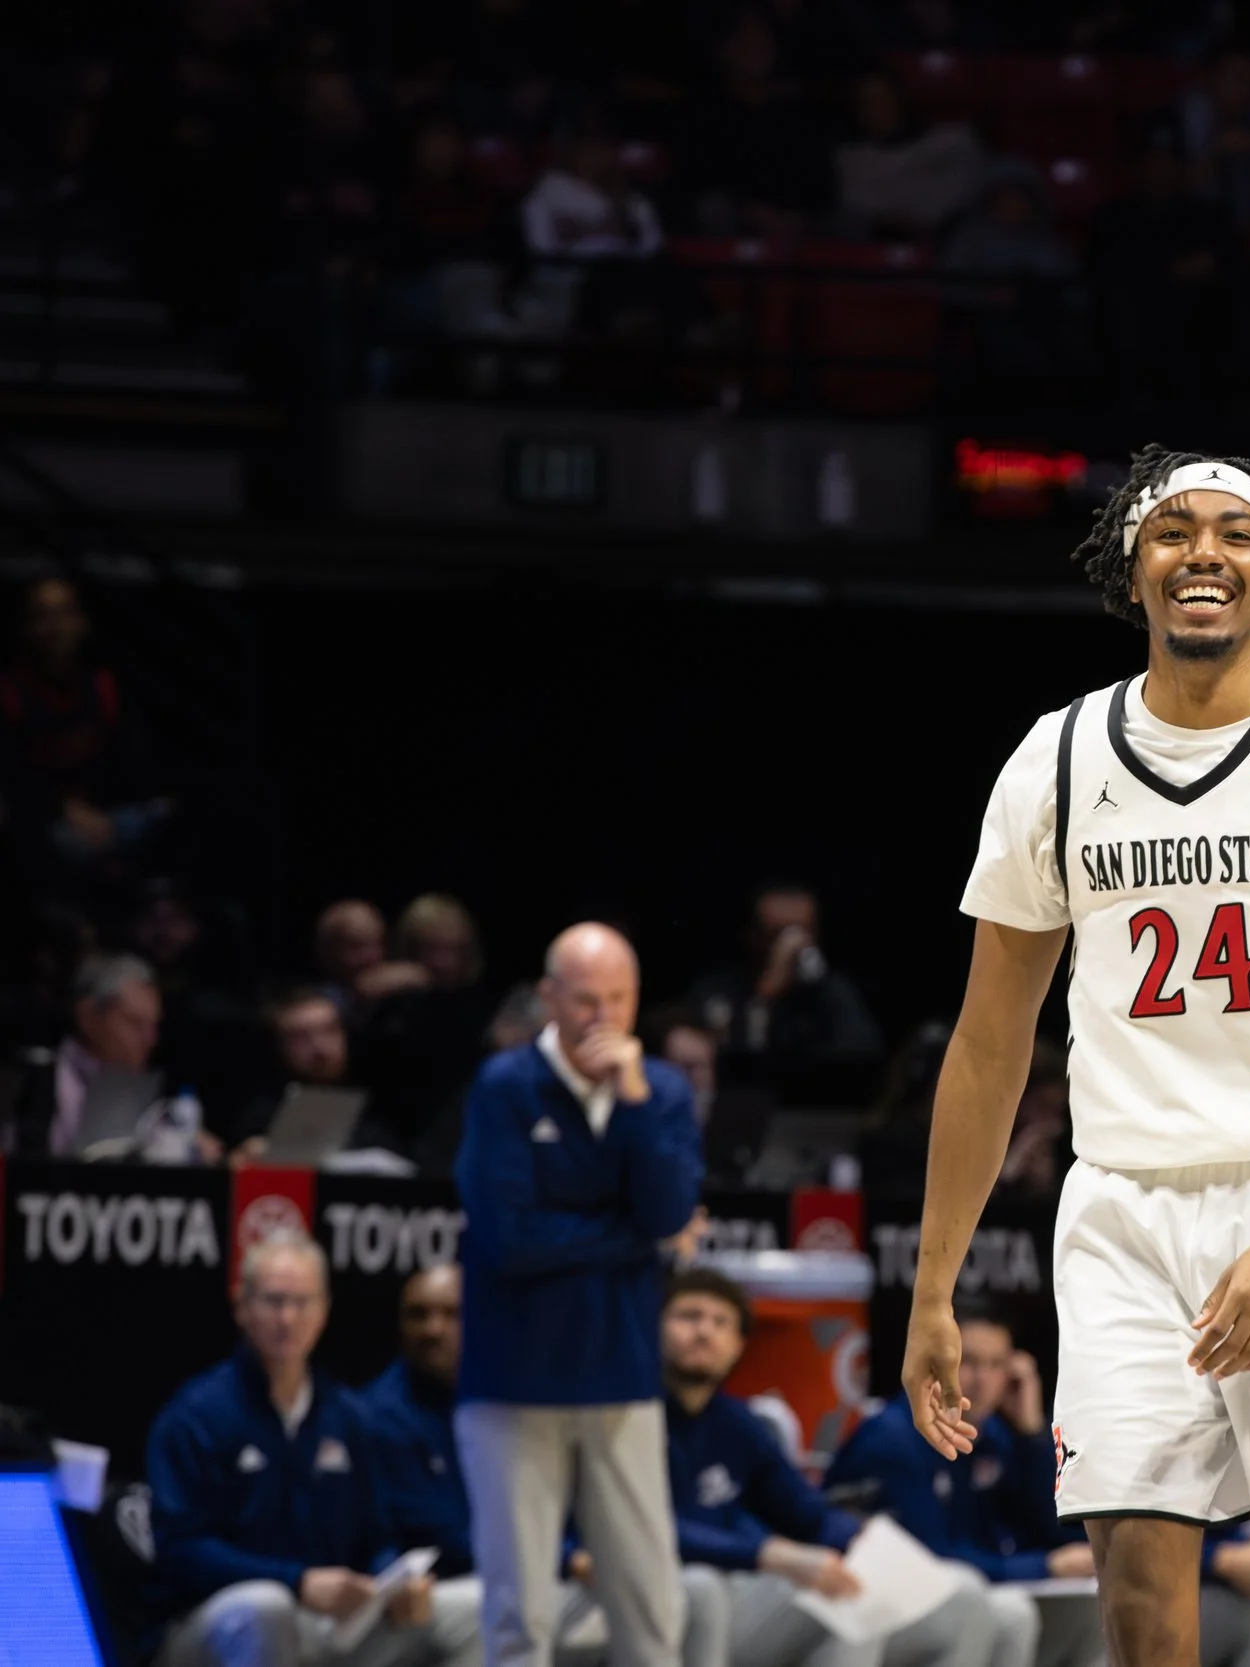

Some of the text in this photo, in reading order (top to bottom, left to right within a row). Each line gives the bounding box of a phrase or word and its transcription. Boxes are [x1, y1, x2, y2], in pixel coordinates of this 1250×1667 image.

[1081, 842, 1125, 892] SAN
[1130, 836, 1212, 888] DIEGO
[18, 1192, 219, 1267] TOYOTA
[325, 1204, 467, 1273] TOYO
